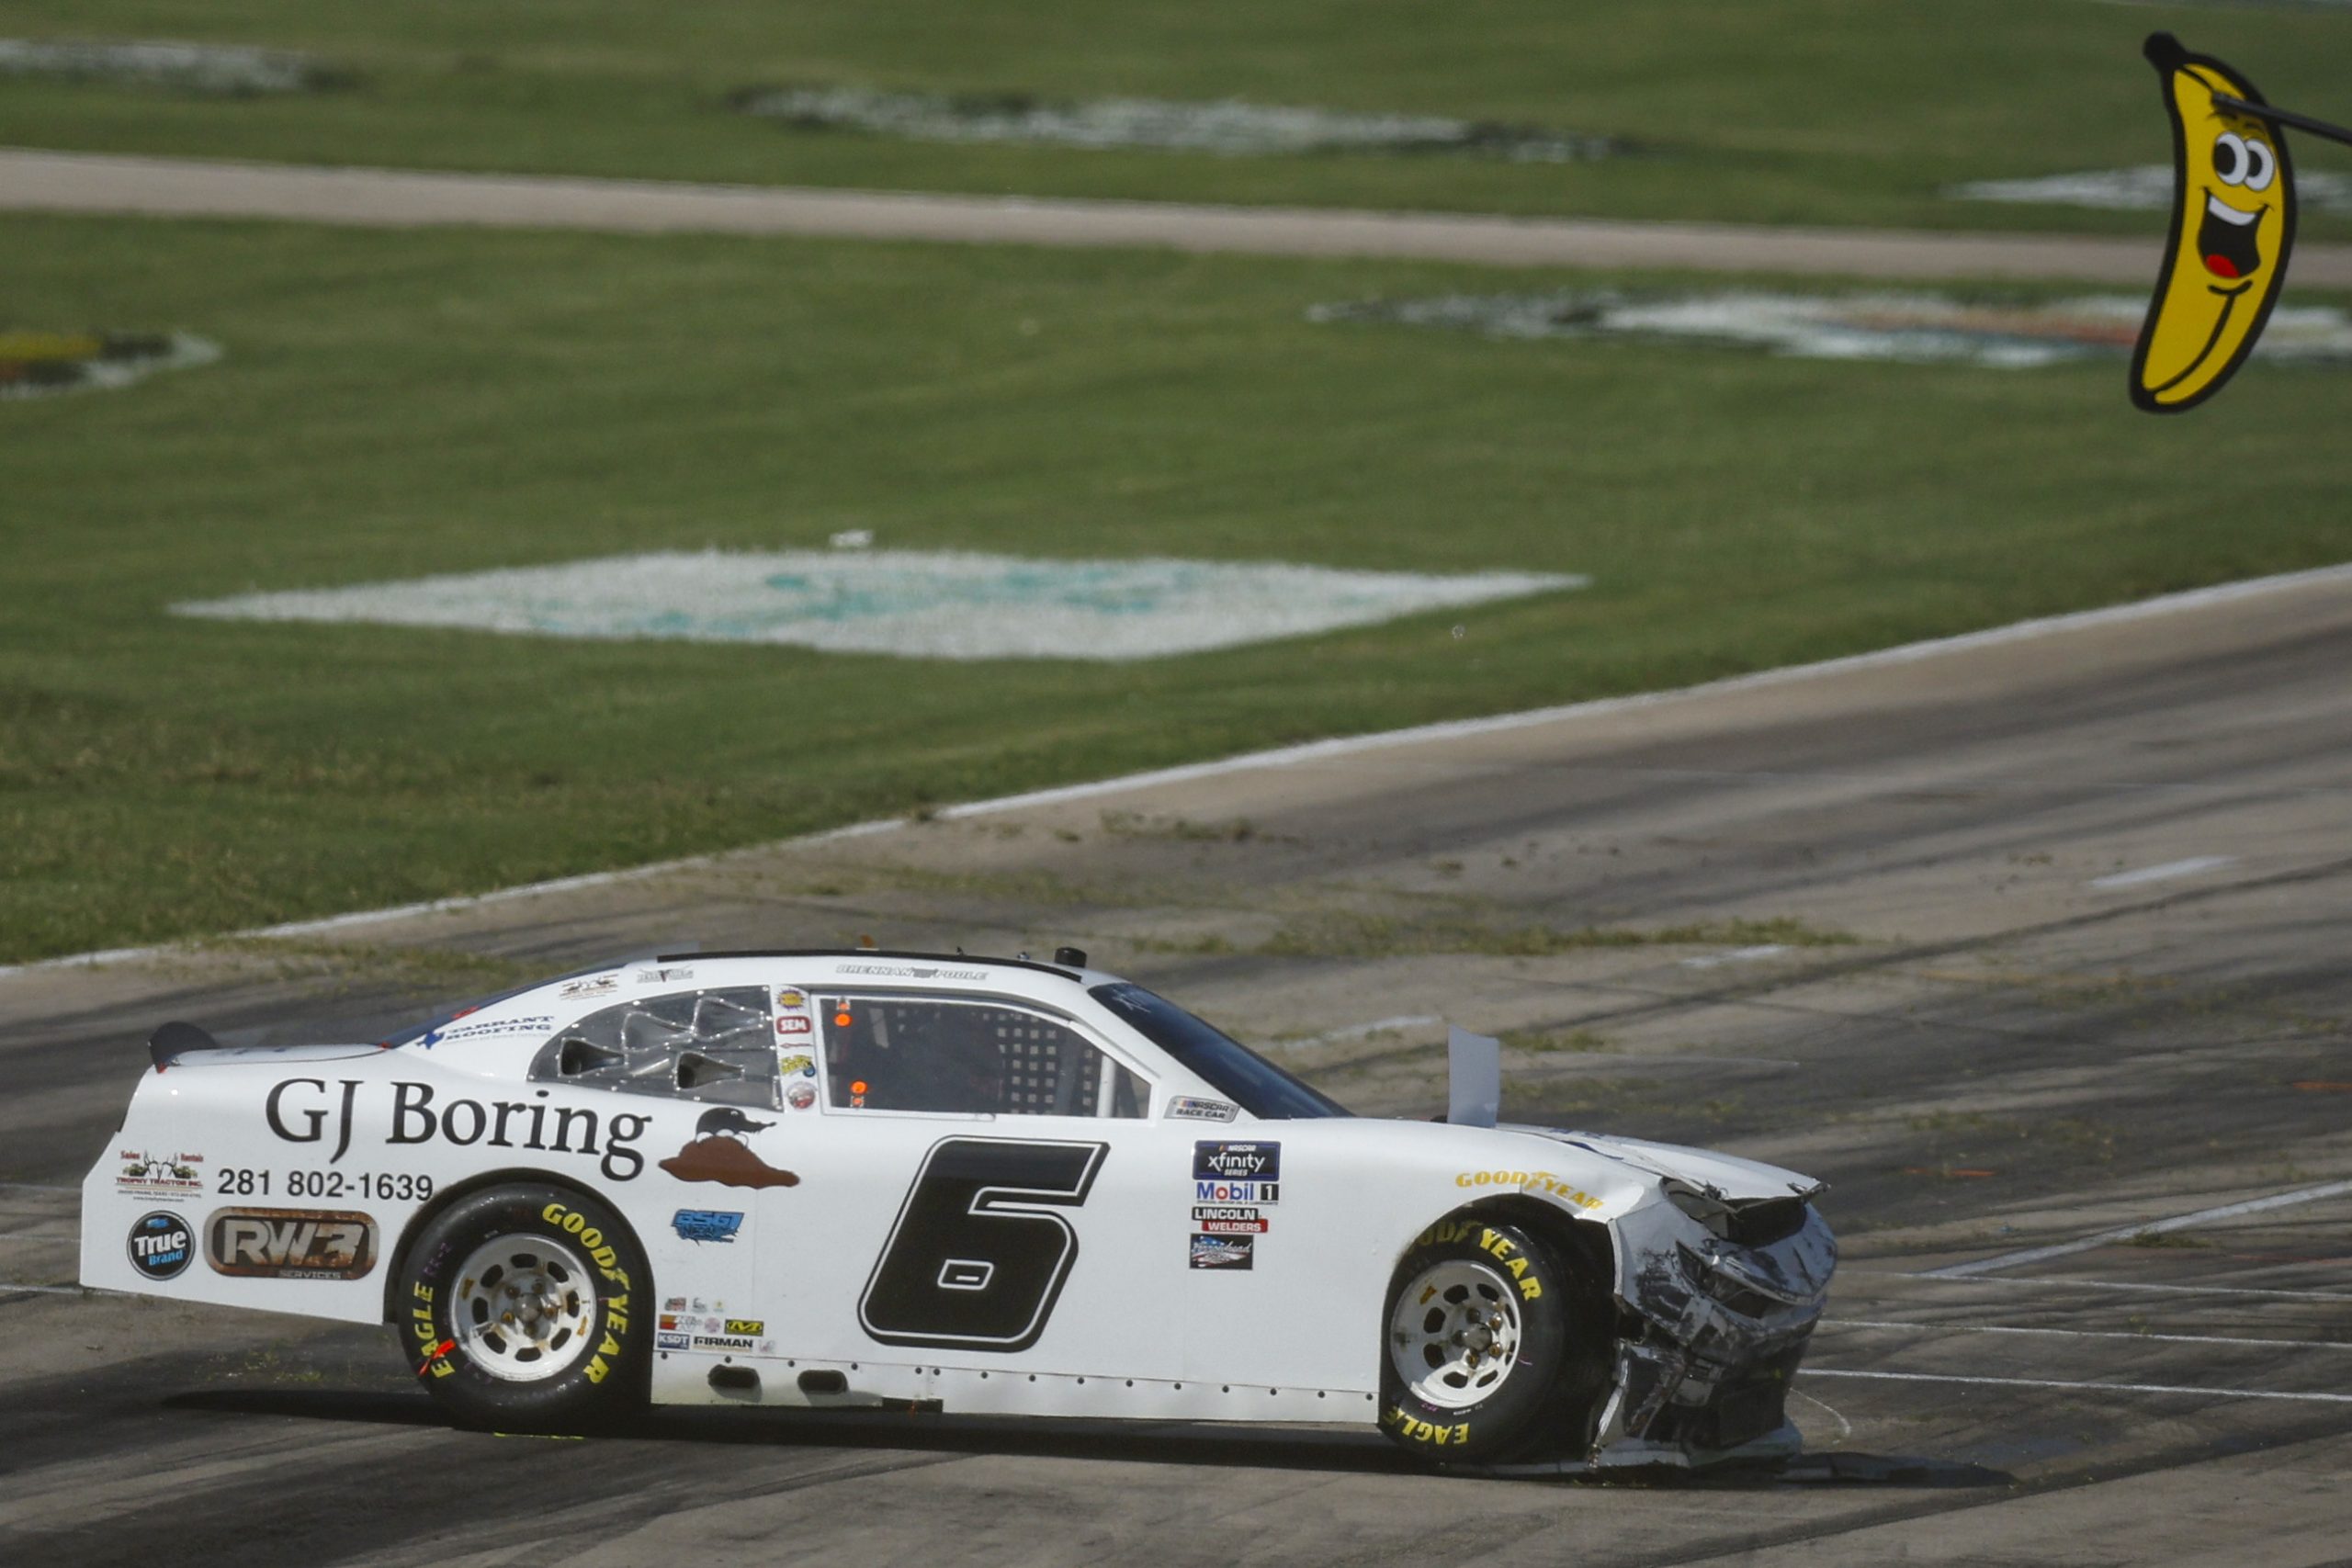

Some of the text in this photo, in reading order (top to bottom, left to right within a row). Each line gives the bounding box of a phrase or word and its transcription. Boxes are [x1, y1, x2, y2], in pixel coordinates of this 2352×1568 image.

[781, 1019, 808, 1031] SEM
[1192, 1100, 1229, 1112] NASCAR
[1176, 1108, 1226, 1119] RACE CAR
[266, 1077, 653, 1181] GJ Boring
[1207, 1152, 1266, 1173] xfinity
[1224, 1168, 1249, 1177] SERIES
[217, 1168, 434, 1201] 281 802-1639
[1196, 1181, 1254, 1201] Mobil
[1194, 1209, 1257, 1221] LINCOLN
[1207, 1221, 1262, 1233] WELDERS
[134, 1230, 187, 1258] True
[857, 1134, 1111, 1353] 6
[148, 1248, 184, 1267] Brand
[278, 1269, 342, 1280] SERVICES
[658, 1334, 689, 1344] KSDT
[694, 1336, 753, 1348] FIRMAN
